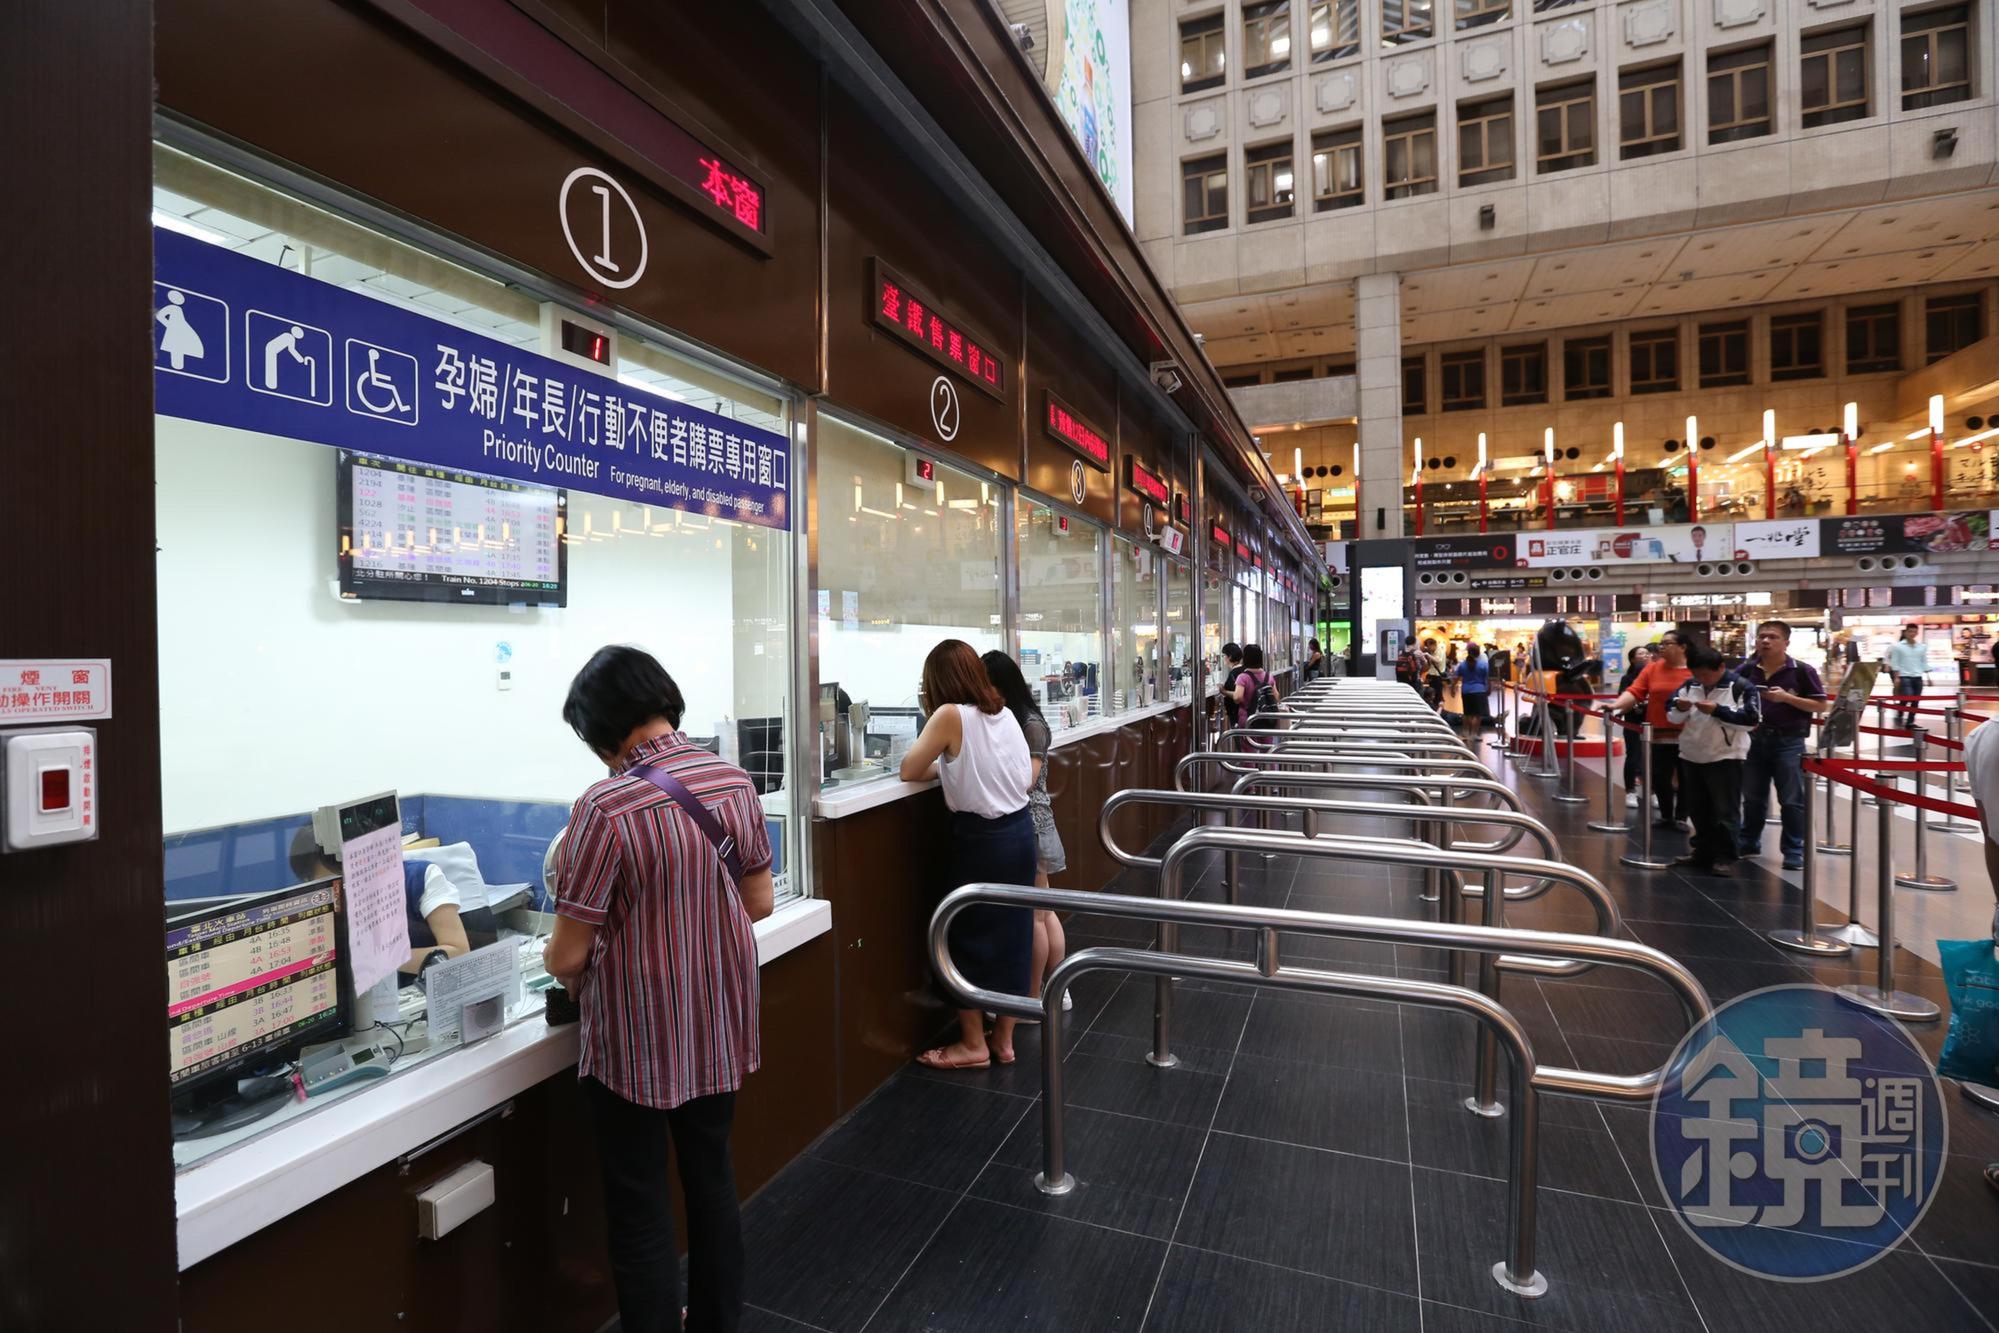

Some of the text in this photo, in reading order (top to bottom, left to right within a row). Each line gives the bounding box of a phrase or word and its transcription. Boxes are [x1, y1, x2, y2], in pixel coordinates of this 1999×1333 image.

[592, 185, 620, 273] 1
[594, 337, 602, 361] 1
[435, 344, 786, 491] 孕婦/年長/行動不便者購票專用窗口
[939, 384, 951, 432] 2
[483, 429, 541, 473] Priority
[545, 444, 600, 479] Counter
[610, 466, 765, 515] For pregnant, elderly, and disabled passenger
[1546, 545, 1582, 555] 正官庄
[499, 579, 519, 587] Stops
